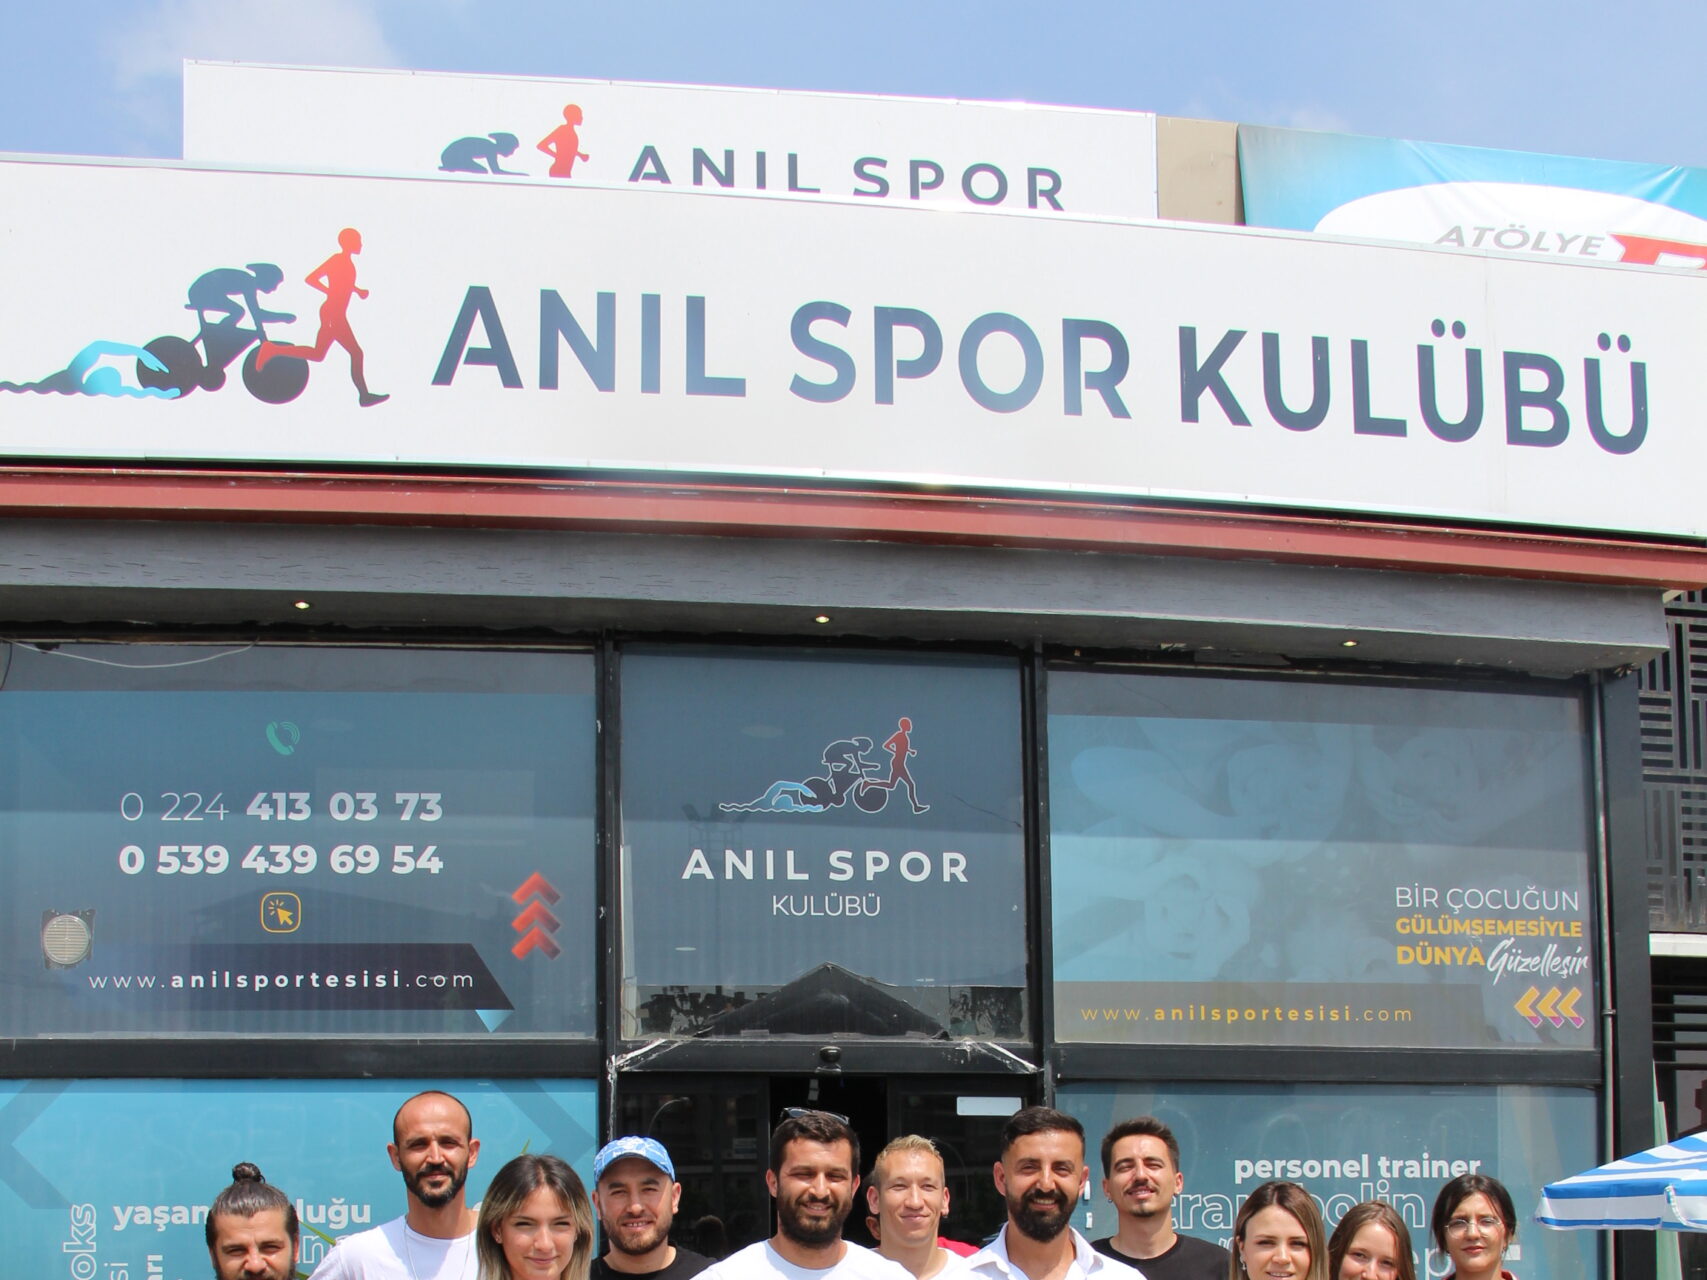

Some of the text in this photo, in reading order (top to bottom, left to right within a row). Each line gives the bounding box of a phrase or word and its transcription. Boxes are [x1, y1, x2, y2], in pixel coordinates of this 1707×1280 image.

[628, 145, 1065, 211] ANIL SPOR
[1434, 223, 1606, 256] ATÖLYE
[430, 285, 1649, 456] ANIL SPOR KULÜBÜ
[120, 792, 443, 821] 0 224 413 03 73
[119, 845, 444, 875] 0 539 439 69 54
[681, 849, 969, 883] ANIL SPOR
[772, 892, 881, 917] KULÜBÜ
[1395, 882, 1579, 914] BİR ÇOCUĞUN
[1395, 914, 1583, 938] GÜLÜMSEMESİYLE
[1396, 937, 1589, 986] DÜNYA Güzelleşir
[88, 970, 474, 992] www.anilsportesisi.com
[1080, 1004, 1413, 1025] www.anilsportesisi.com
[1234, 1151, 1481, 1185] personel trainer
